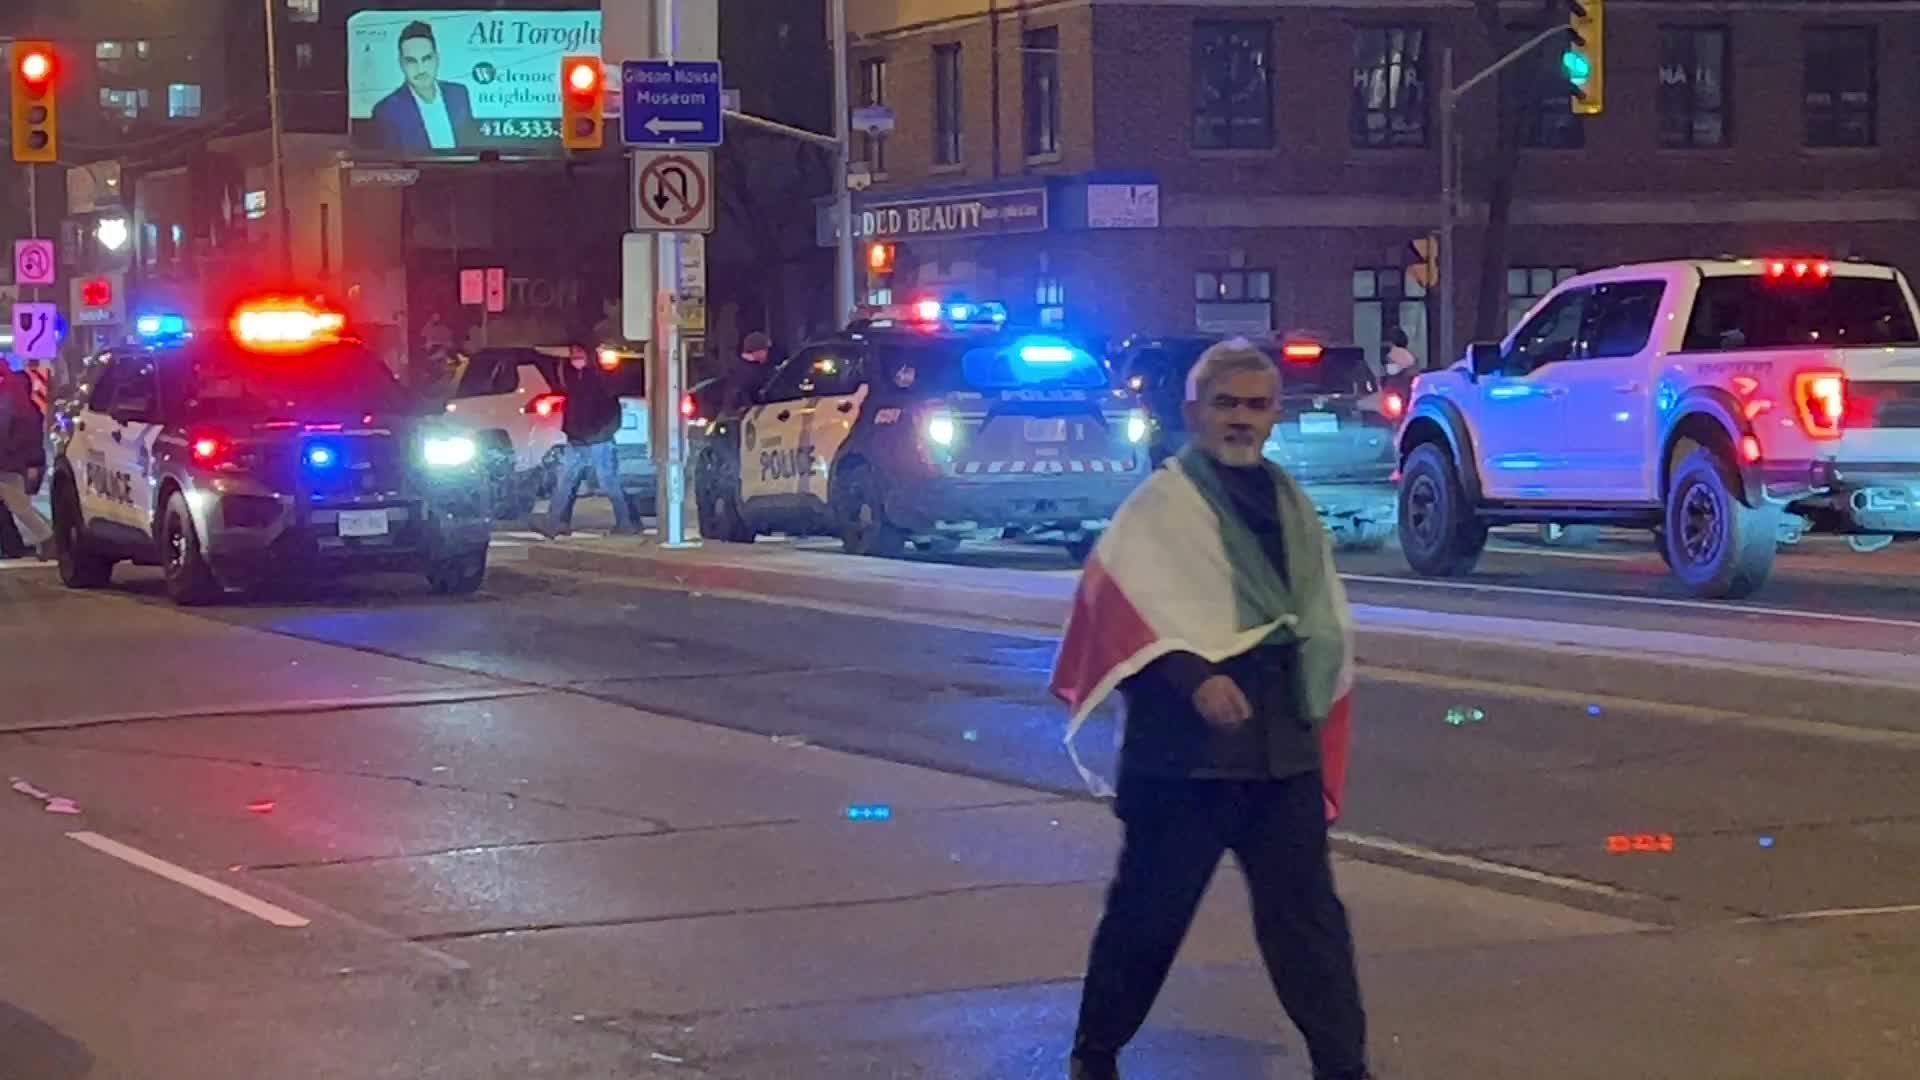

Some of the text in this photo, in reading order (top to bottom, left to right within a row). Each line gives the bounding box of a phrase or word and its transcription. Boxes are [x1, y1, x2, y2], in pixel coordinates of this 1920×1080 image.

[468, 20, 601, 51] Ali Torogh
[472, 62, 554, 85] Welcome
[624, 69, 718, 83] Gibson House
[637, 91, 706, 105] Museum
[907, 202, 980, 233] BEAUTY
[760, 446, 817, 482] POLICE
